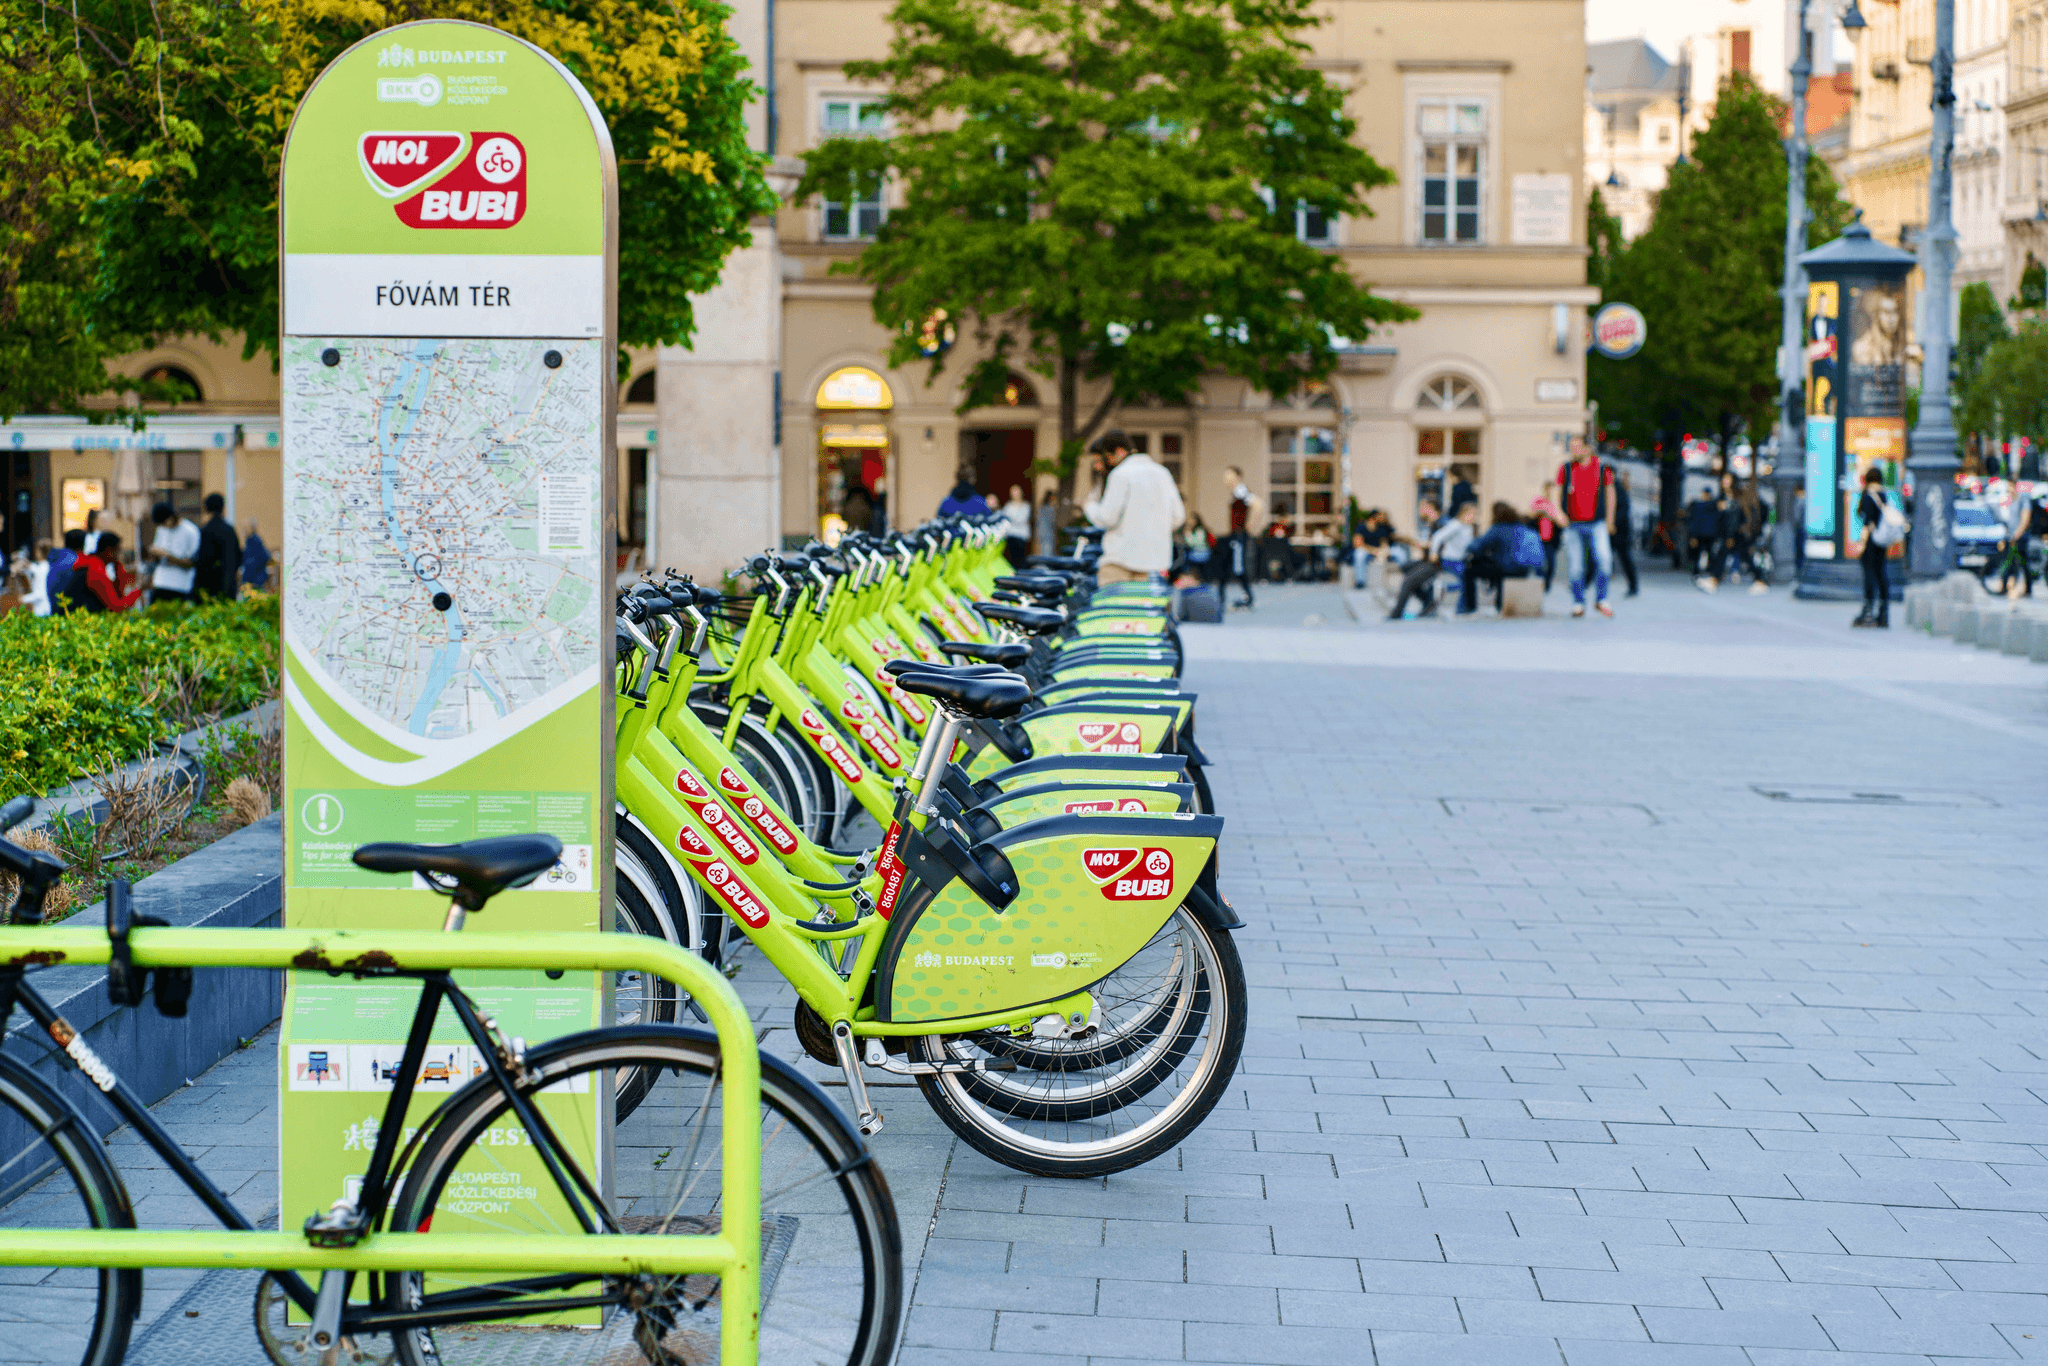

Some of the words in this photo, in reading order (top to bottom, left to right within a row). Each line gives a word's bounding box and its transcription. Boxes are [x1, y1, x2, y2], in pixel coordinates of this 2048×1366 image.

[418, 50, 508, 64] BUDAPEST
[372, 140, 429, 165] MOL
[420, 191, 518, 221] BUBI
[376, 280, 459, 307] FŐVÁM
[469, 280, 511, 307] TÉR
[680, 773, 700, 792] MOL
[723, 771, 740, 788] MOL
[682, 831, 704, 850] MOL
[716, 820, 755, 859] BUBI
[757, 813, 794, 850] BUBI
[881, 833, 900, 870] 860833
[1089, 853, 1120, 866] MOL
[881, 869, 902, 909] 860487
[1115, 879, 1170, 897] BUBI
[721, 880, 765, 922] BUBI
[945, 955, 1014, 966] BUDAPEST
[449, 1171, 521, 1185] BUDAPESTI
[448, 1184, 537, 1199] KÖZLEKEDÉSI
[448, 1200, 511, 1214] KÖZPONT
